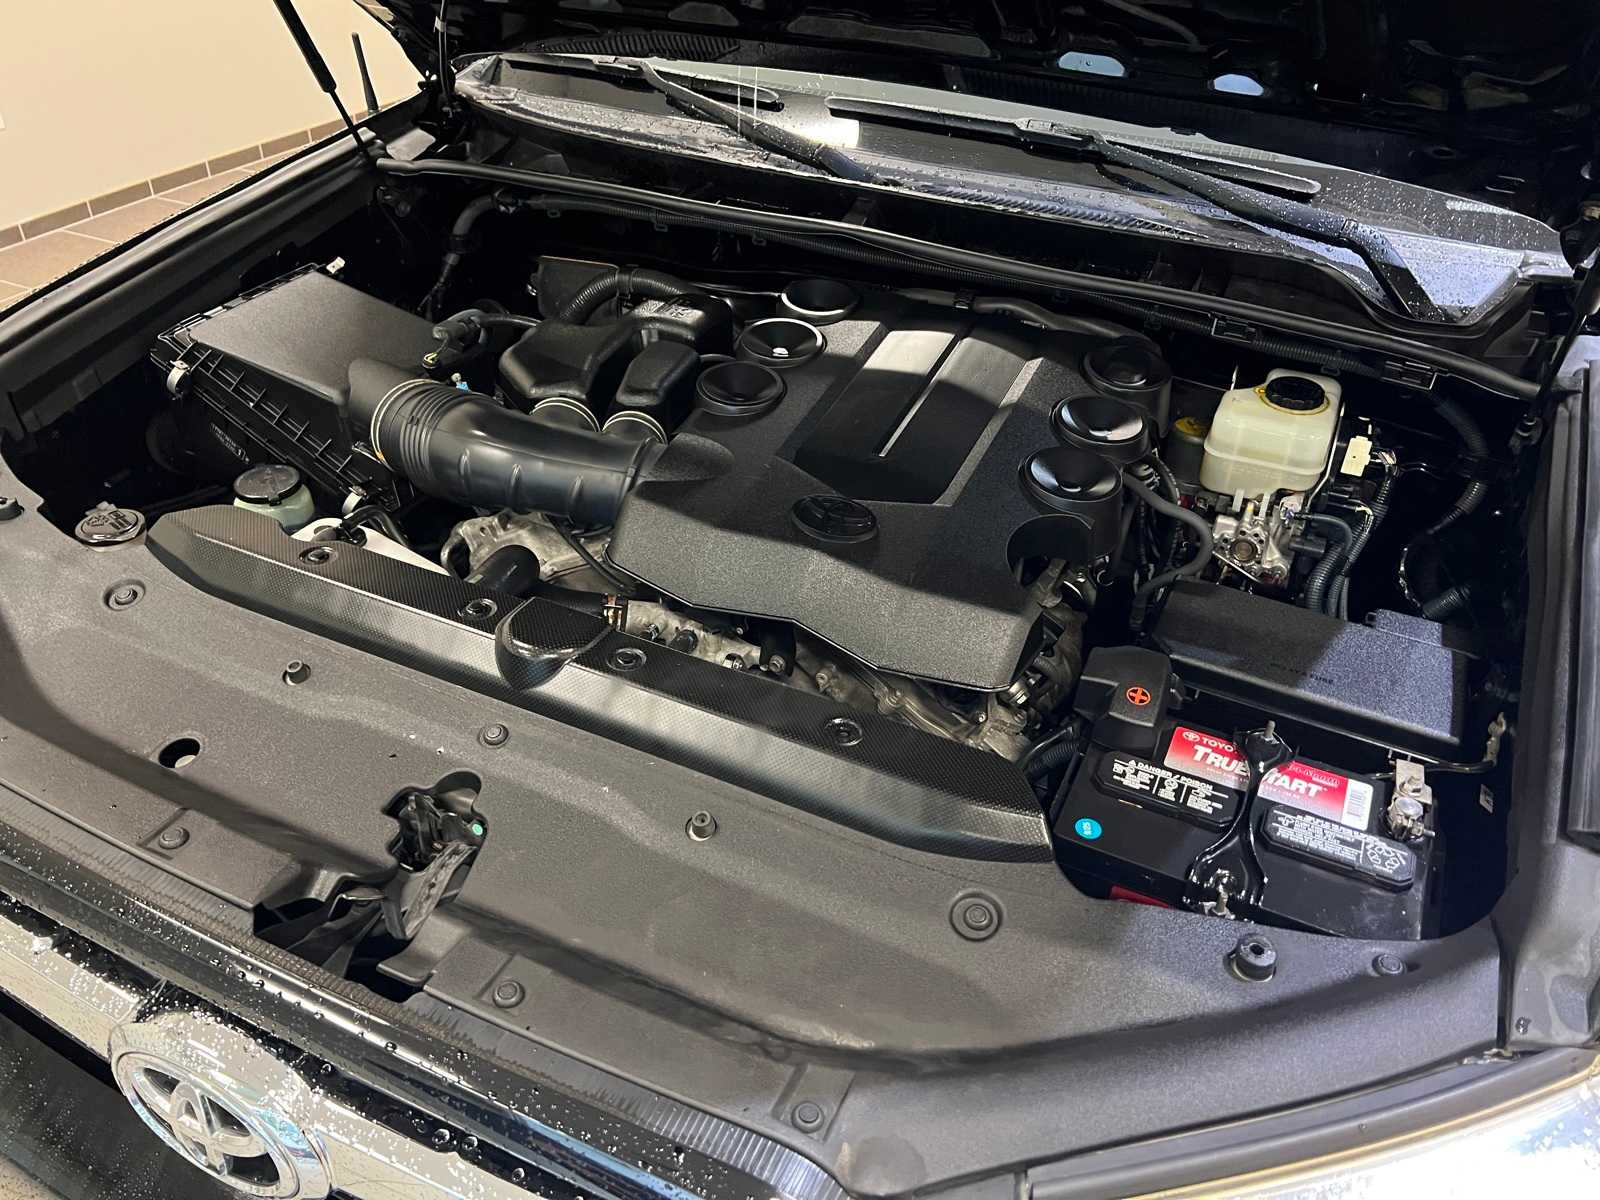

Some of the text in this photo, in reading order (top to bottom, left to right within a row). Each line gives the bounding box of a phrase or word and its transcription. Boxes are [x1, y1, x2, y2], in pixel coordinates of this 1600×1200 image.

[1202, 737, 1235, 752] TOYO
[1137, 762, 1173, 778] DANGER
[1180, 776, 1213, 792] POISON
[1193, 745, 1249, 777] TRUE
[1263, 768, 1322, 798] TART
